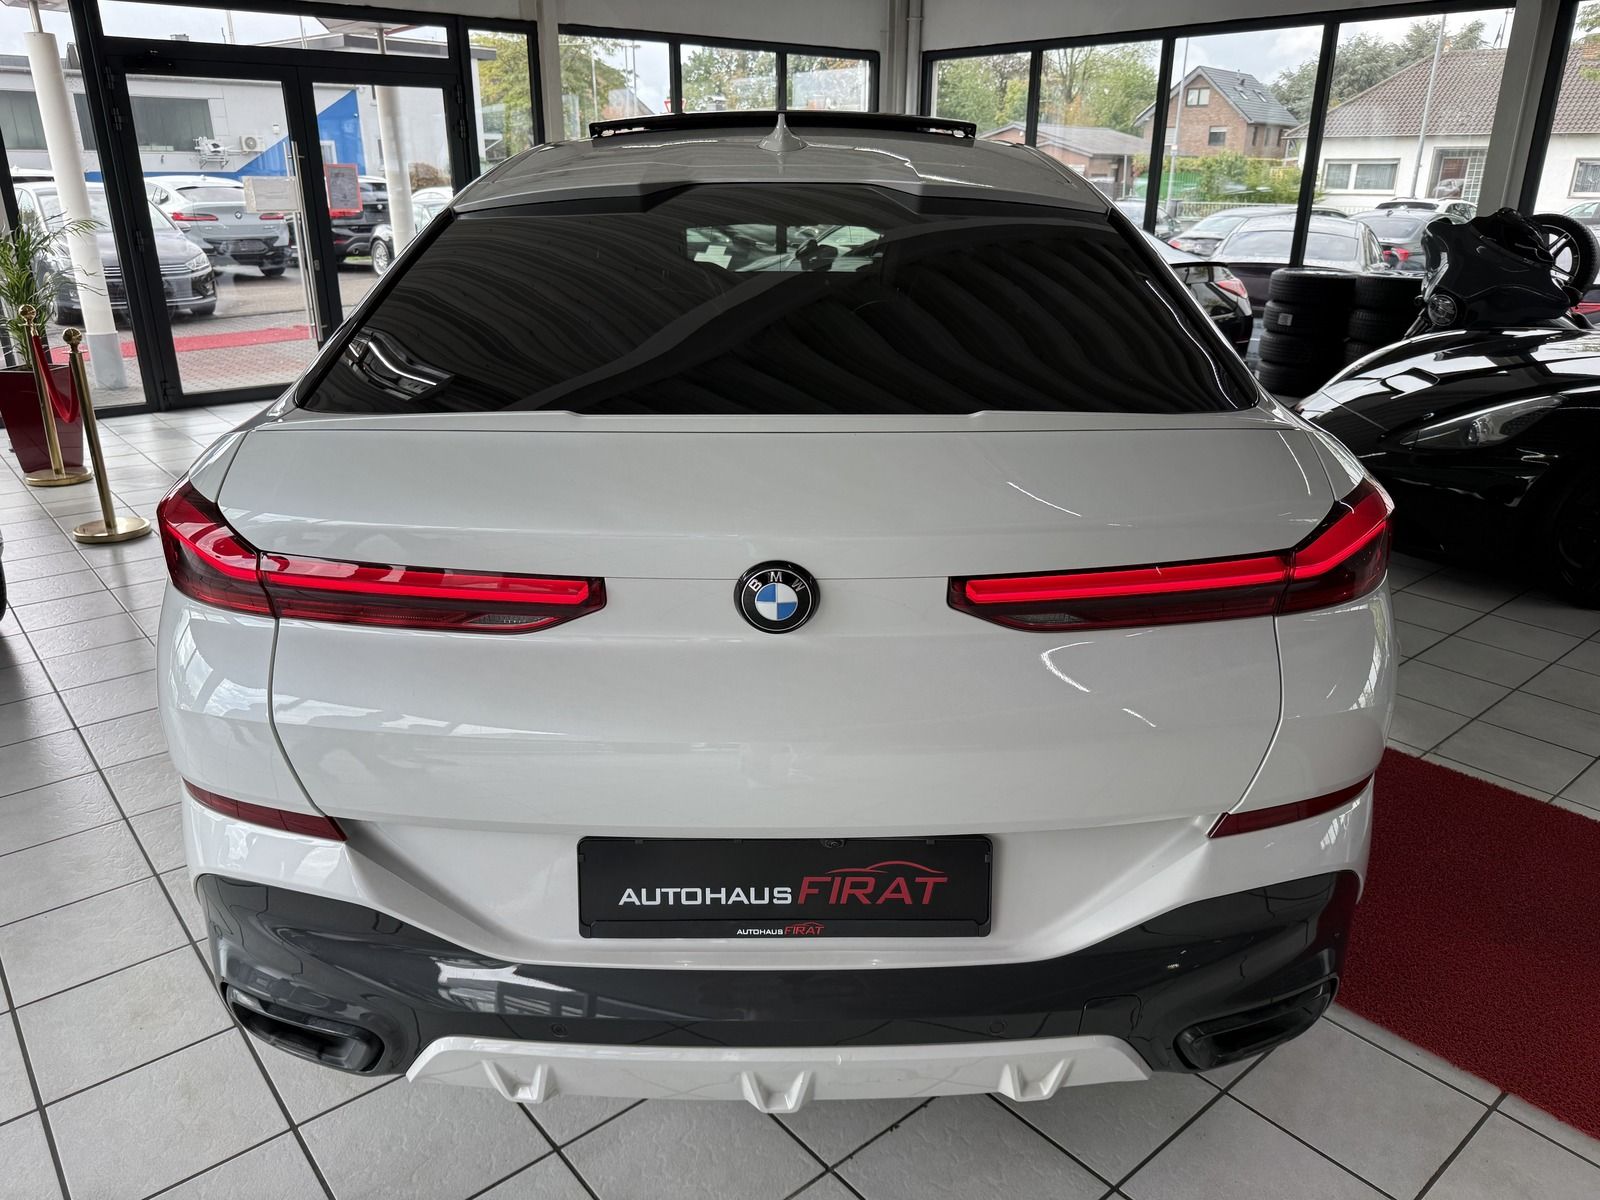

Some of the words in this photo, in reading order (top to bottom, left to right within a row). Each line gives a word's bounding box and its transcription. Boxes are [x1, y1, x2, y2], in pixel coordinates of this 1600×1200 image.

[748, 571, 806, 592] BMW
[618, 887, 792, 906] AUTOHAUS
[798, 876, 948, 905] FIRAT
[784, 926, 825, 935] FIRAT
